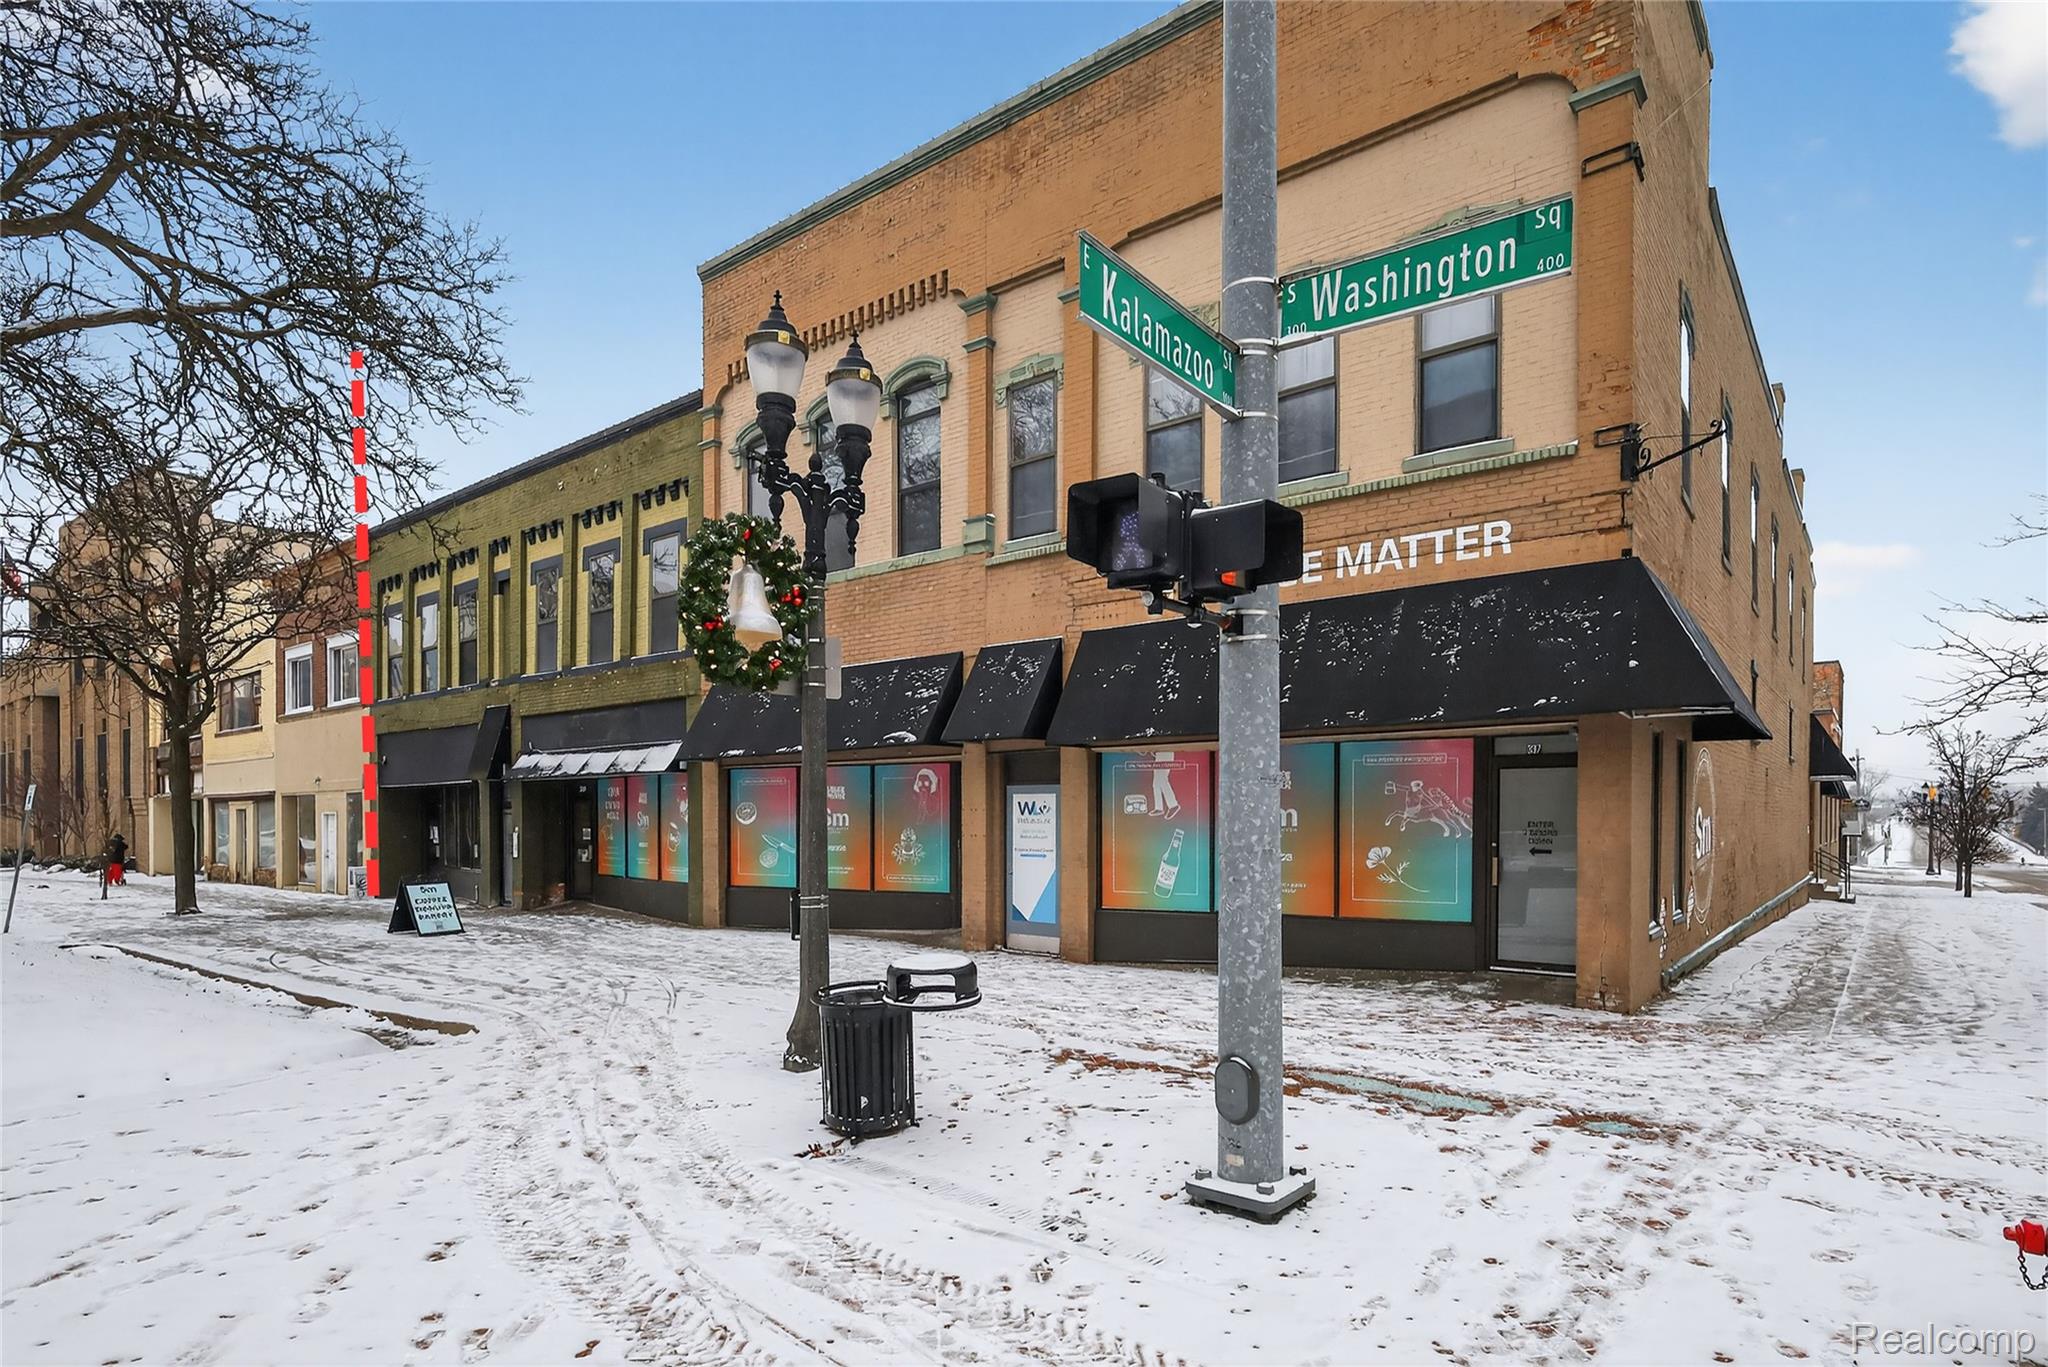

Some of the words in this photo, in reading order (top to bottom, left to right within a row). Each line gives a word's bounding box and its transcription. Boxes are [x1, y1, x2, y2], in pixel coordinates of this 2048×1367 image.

[1287, 284, 1297, 303] S
[1312, 237, 1518, 321] Washington
[1535, 202, 1562, 231] Sq
[1536, 252, 1565, 272] 400
[1083, 243, 1090, 269] E
[1102, 262, 1213, 390] Kalamazoo
[1223, 350, 1232, 373] St
[1336, 520, 1512, 579] MATTER
